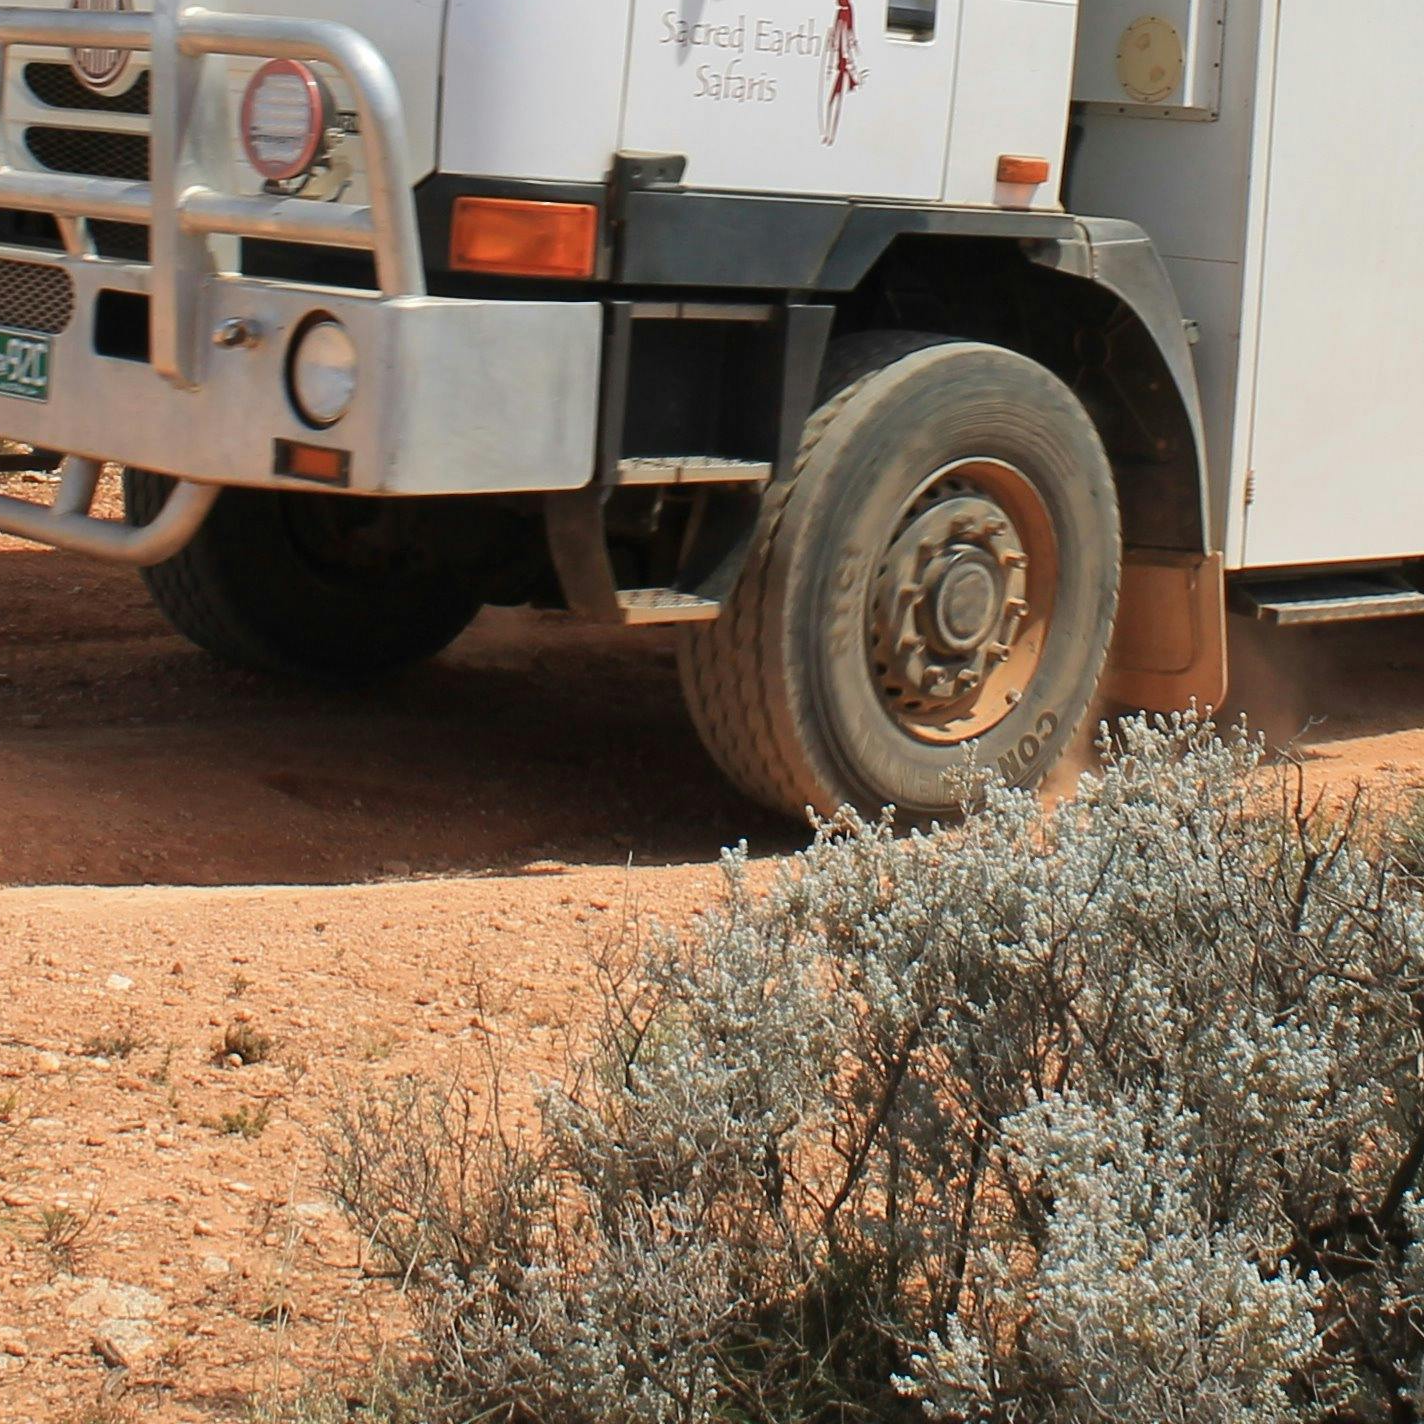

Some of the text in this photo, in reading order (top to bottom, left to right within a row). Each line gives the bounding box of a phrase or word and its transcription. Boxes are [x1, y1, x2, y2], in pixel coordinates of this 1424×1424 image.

[659, 10, 823, 58] Sacred Earth
[692, 58, 778, 103] Safaris
